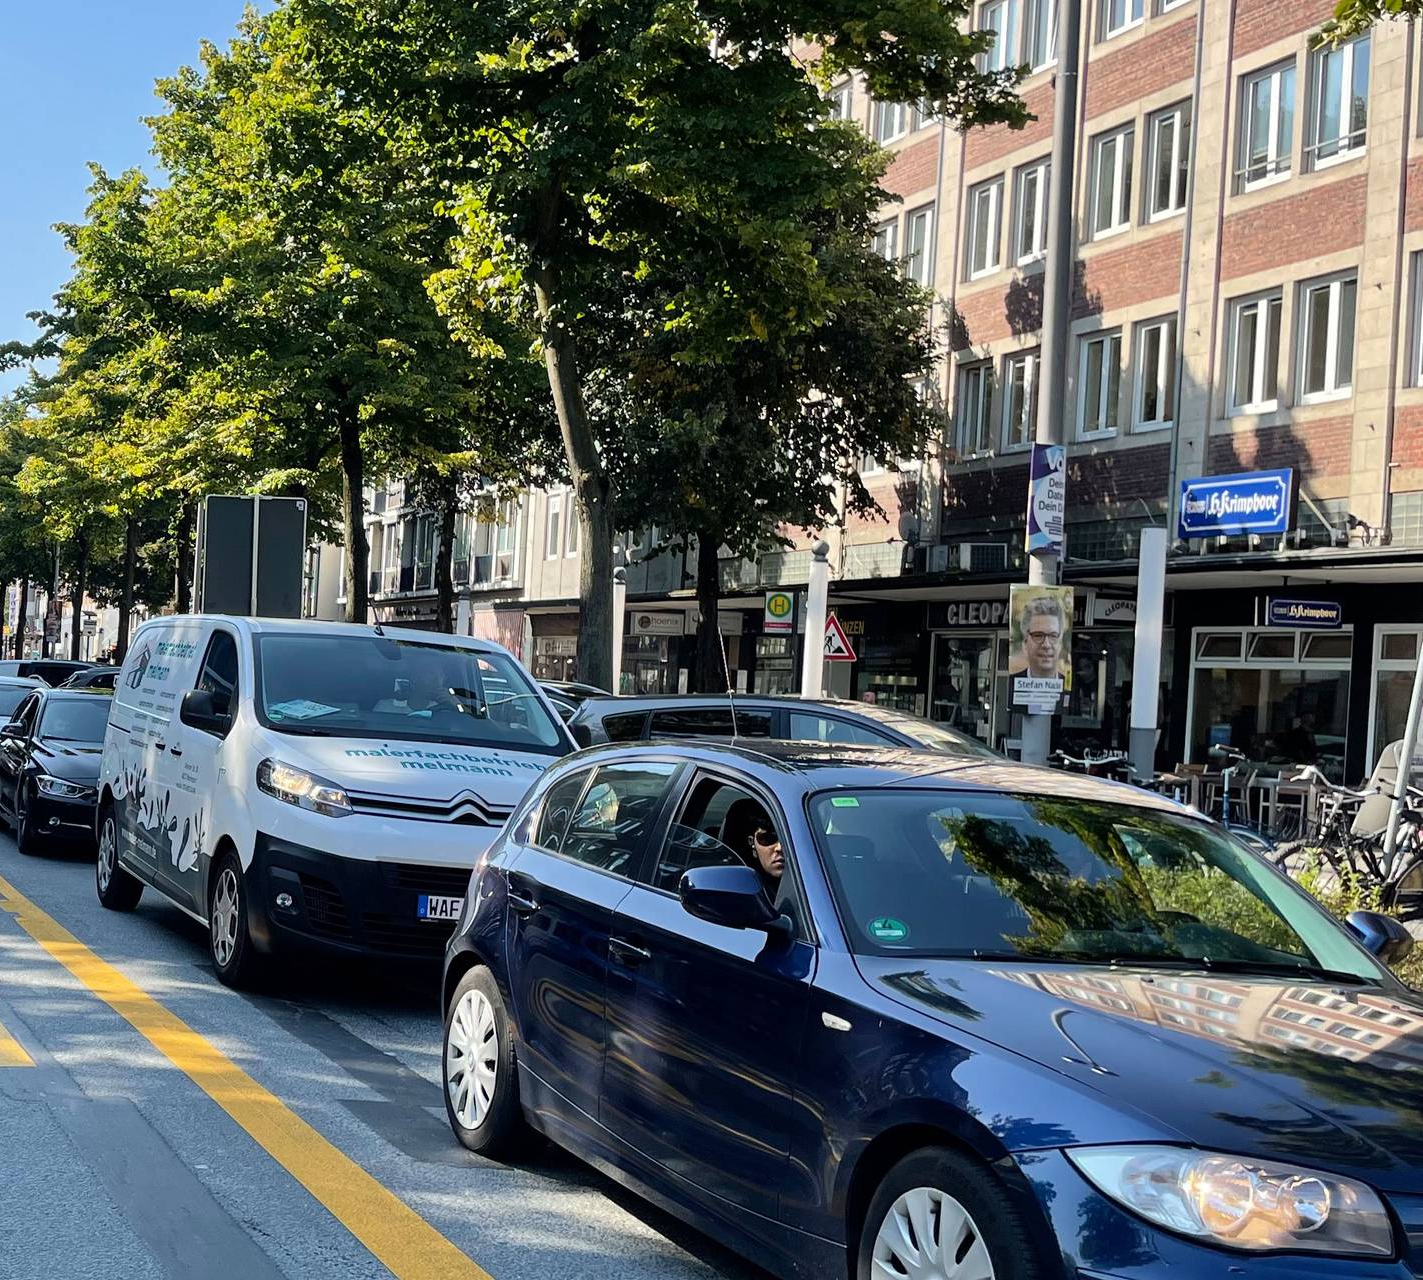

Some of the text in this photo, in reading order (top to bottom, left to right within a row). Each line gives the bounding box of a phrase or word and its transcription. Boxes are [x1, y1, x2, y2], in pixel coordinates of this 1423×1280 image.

[774, 599, 785, 613] H
[1017, 680, 1043, 689] Stefan
[344, 748, 546, 772] malerfachbetrieb
[429, 898, 460, 917] WAF
